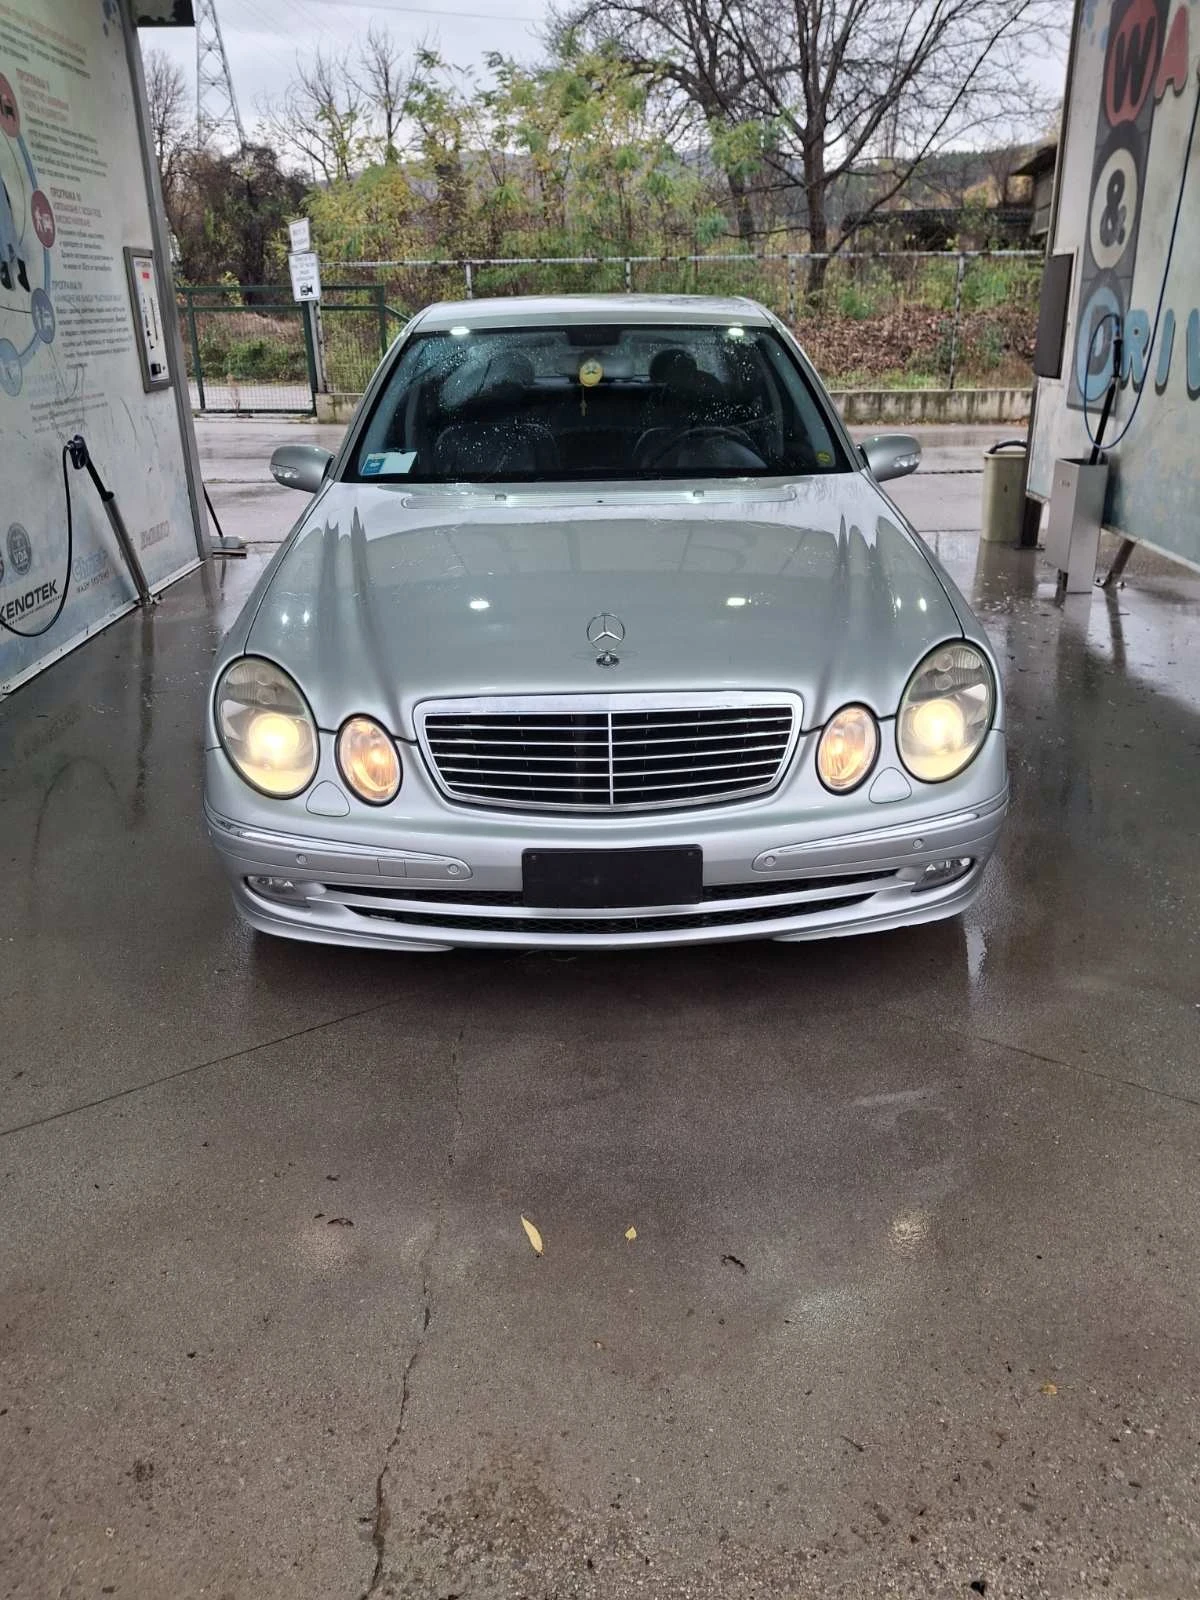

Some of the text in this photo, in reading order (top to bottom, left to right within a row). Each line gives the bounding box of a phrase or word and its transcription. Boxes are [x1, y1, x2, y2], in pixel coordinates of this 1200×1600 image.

[1112, 4, 1200, 113] WA
[1099, 169, 1128, 248] &
[0, 579, 58, 623] KENOTEK
